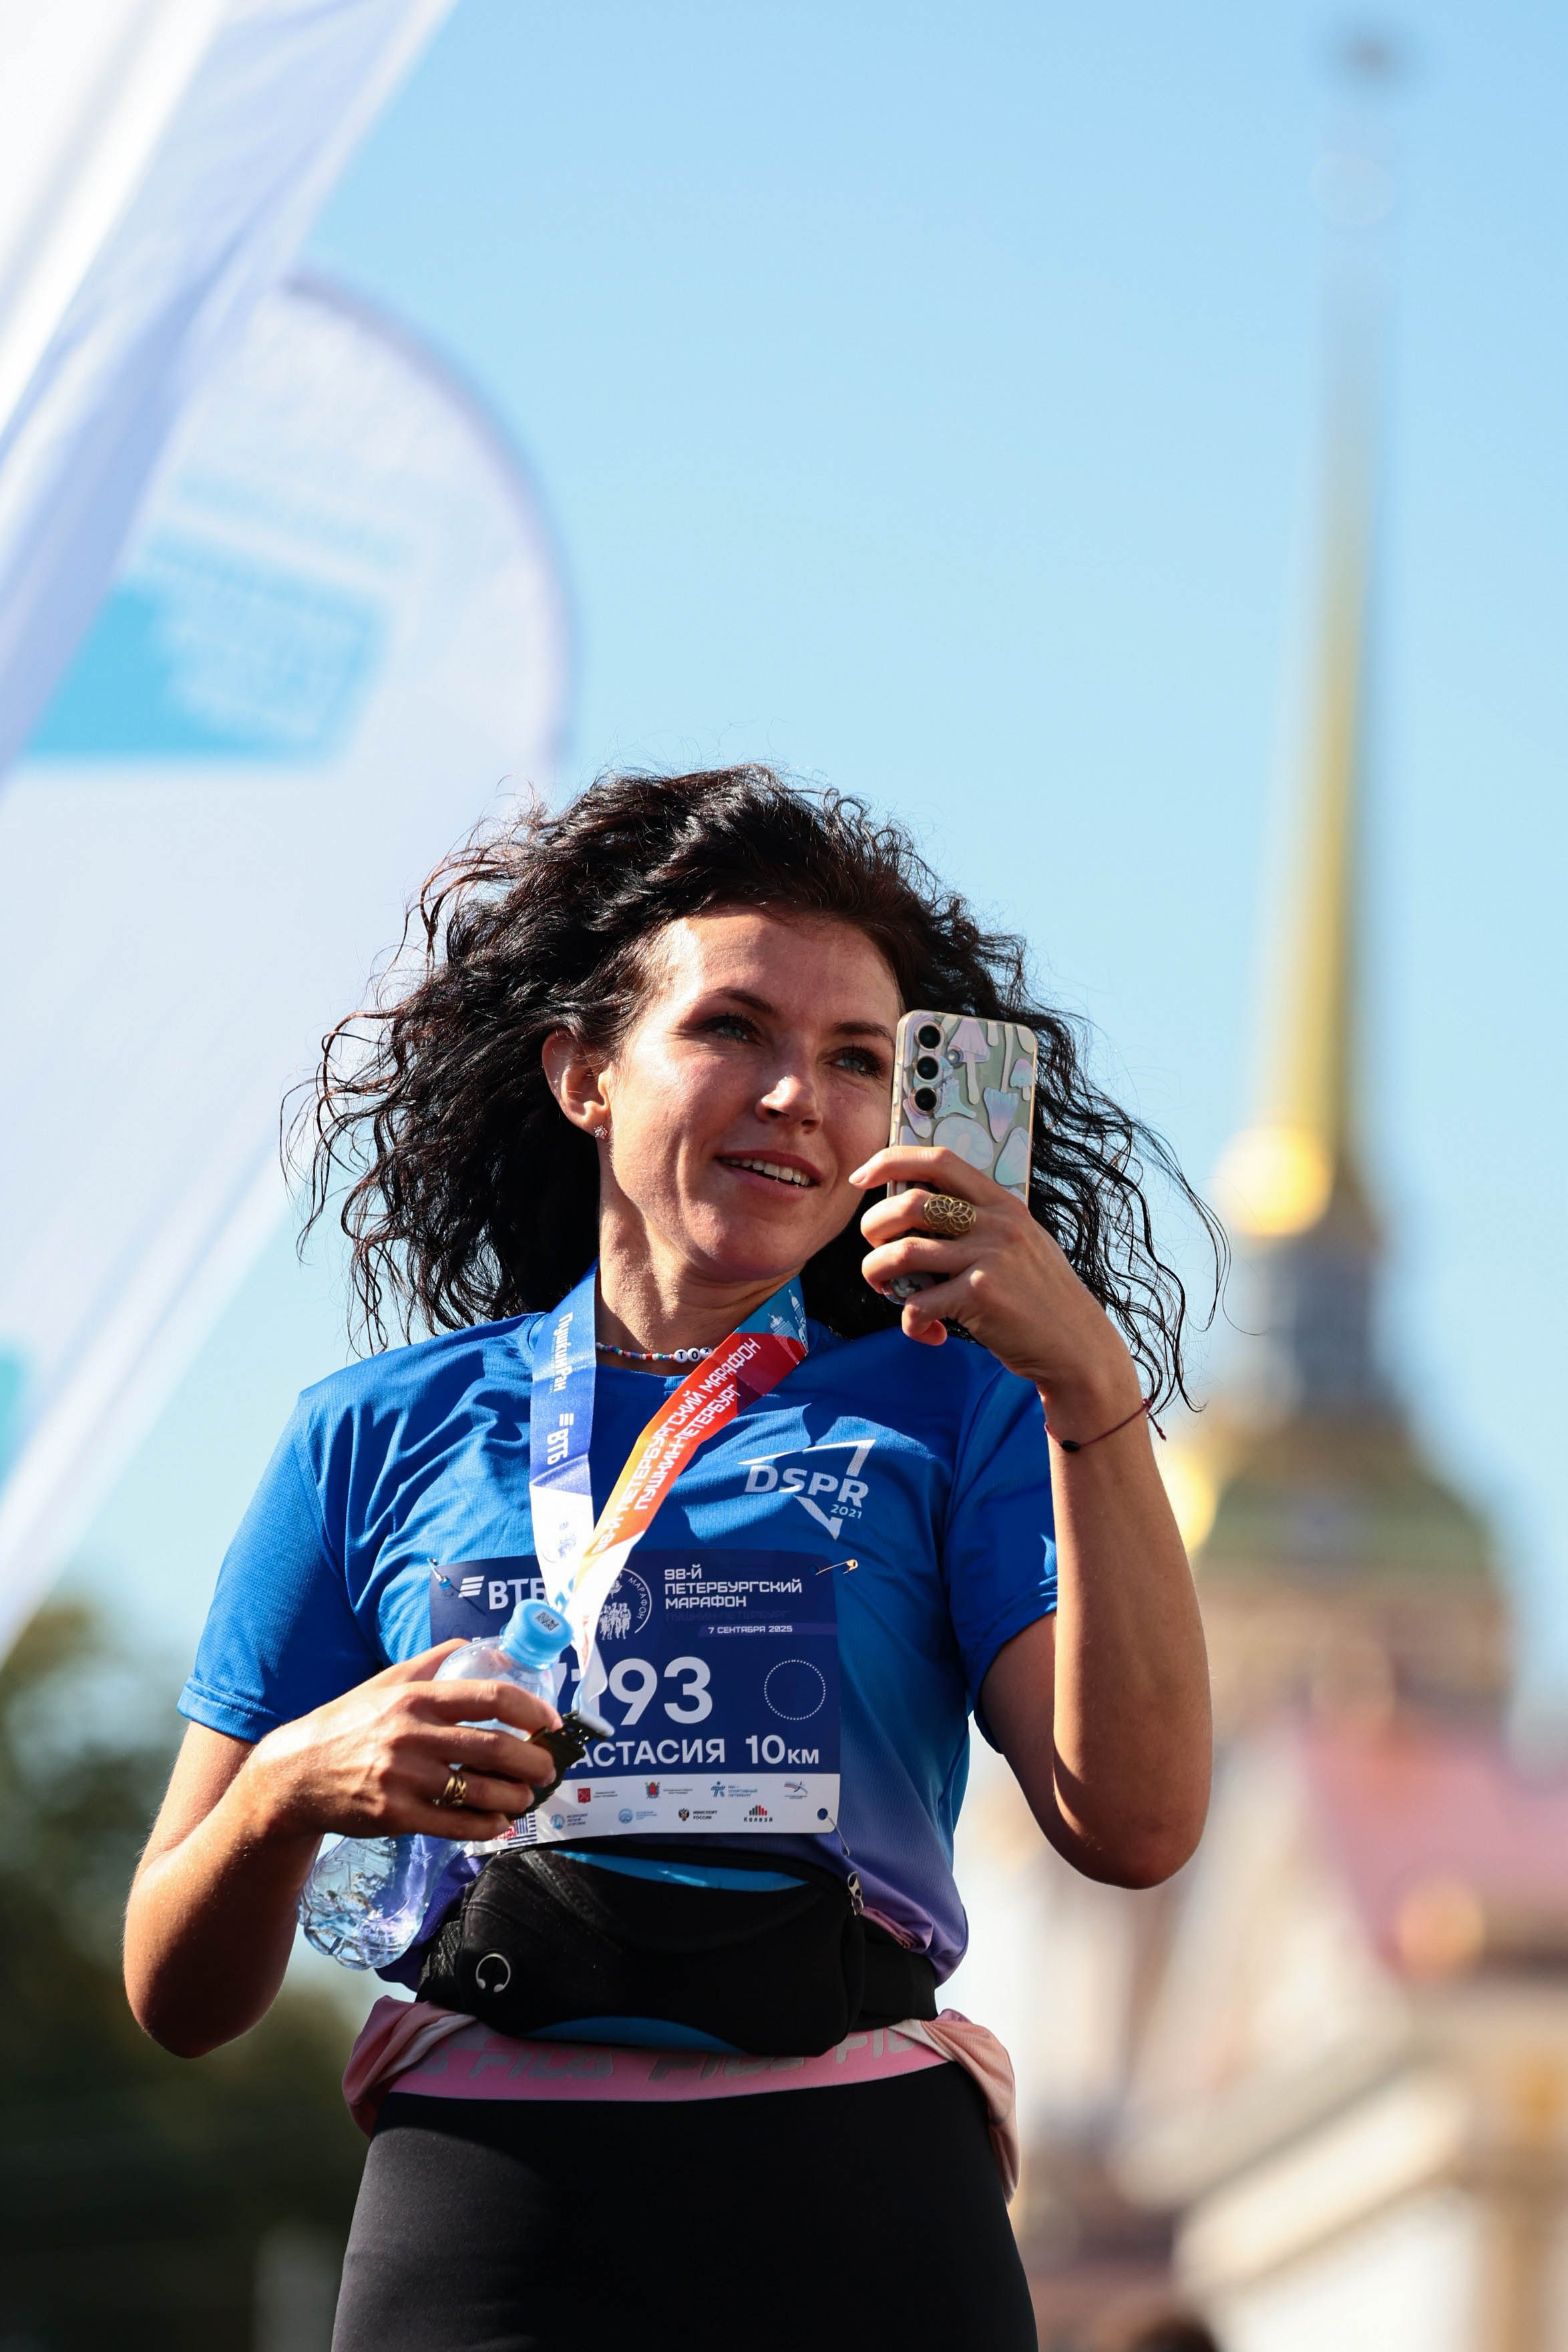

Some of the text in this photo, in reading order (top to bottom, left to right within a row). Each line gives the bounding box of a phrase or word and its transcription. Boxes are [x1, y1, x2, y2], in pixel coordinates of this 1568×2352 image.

[615, 1389, 706, 1512] ПЕТЕРБУРГСКИЙ
[699, 1338, 761, 1394] МАРАФОН
[547, 1428, 568, 1465] ВТБ
[634, 1384, 741, 1511] ПУШКИН-ПЕТЕРБУРГ
[744, 1464, 869, 1508] DSPR
[830, 1504, 862, 1519] 2021
[664, 1563, 702, 1581] 98-Й
[628, 1577, 647, 1619] МАРАФОН
[664, 1579, 802, 1595] ПЕТЕРБУРГСКИЙ
[665, 1595, 747, 1609] МАРАФОН
[717, 1626, 766, 1634] СЕНТЯБРЯ
